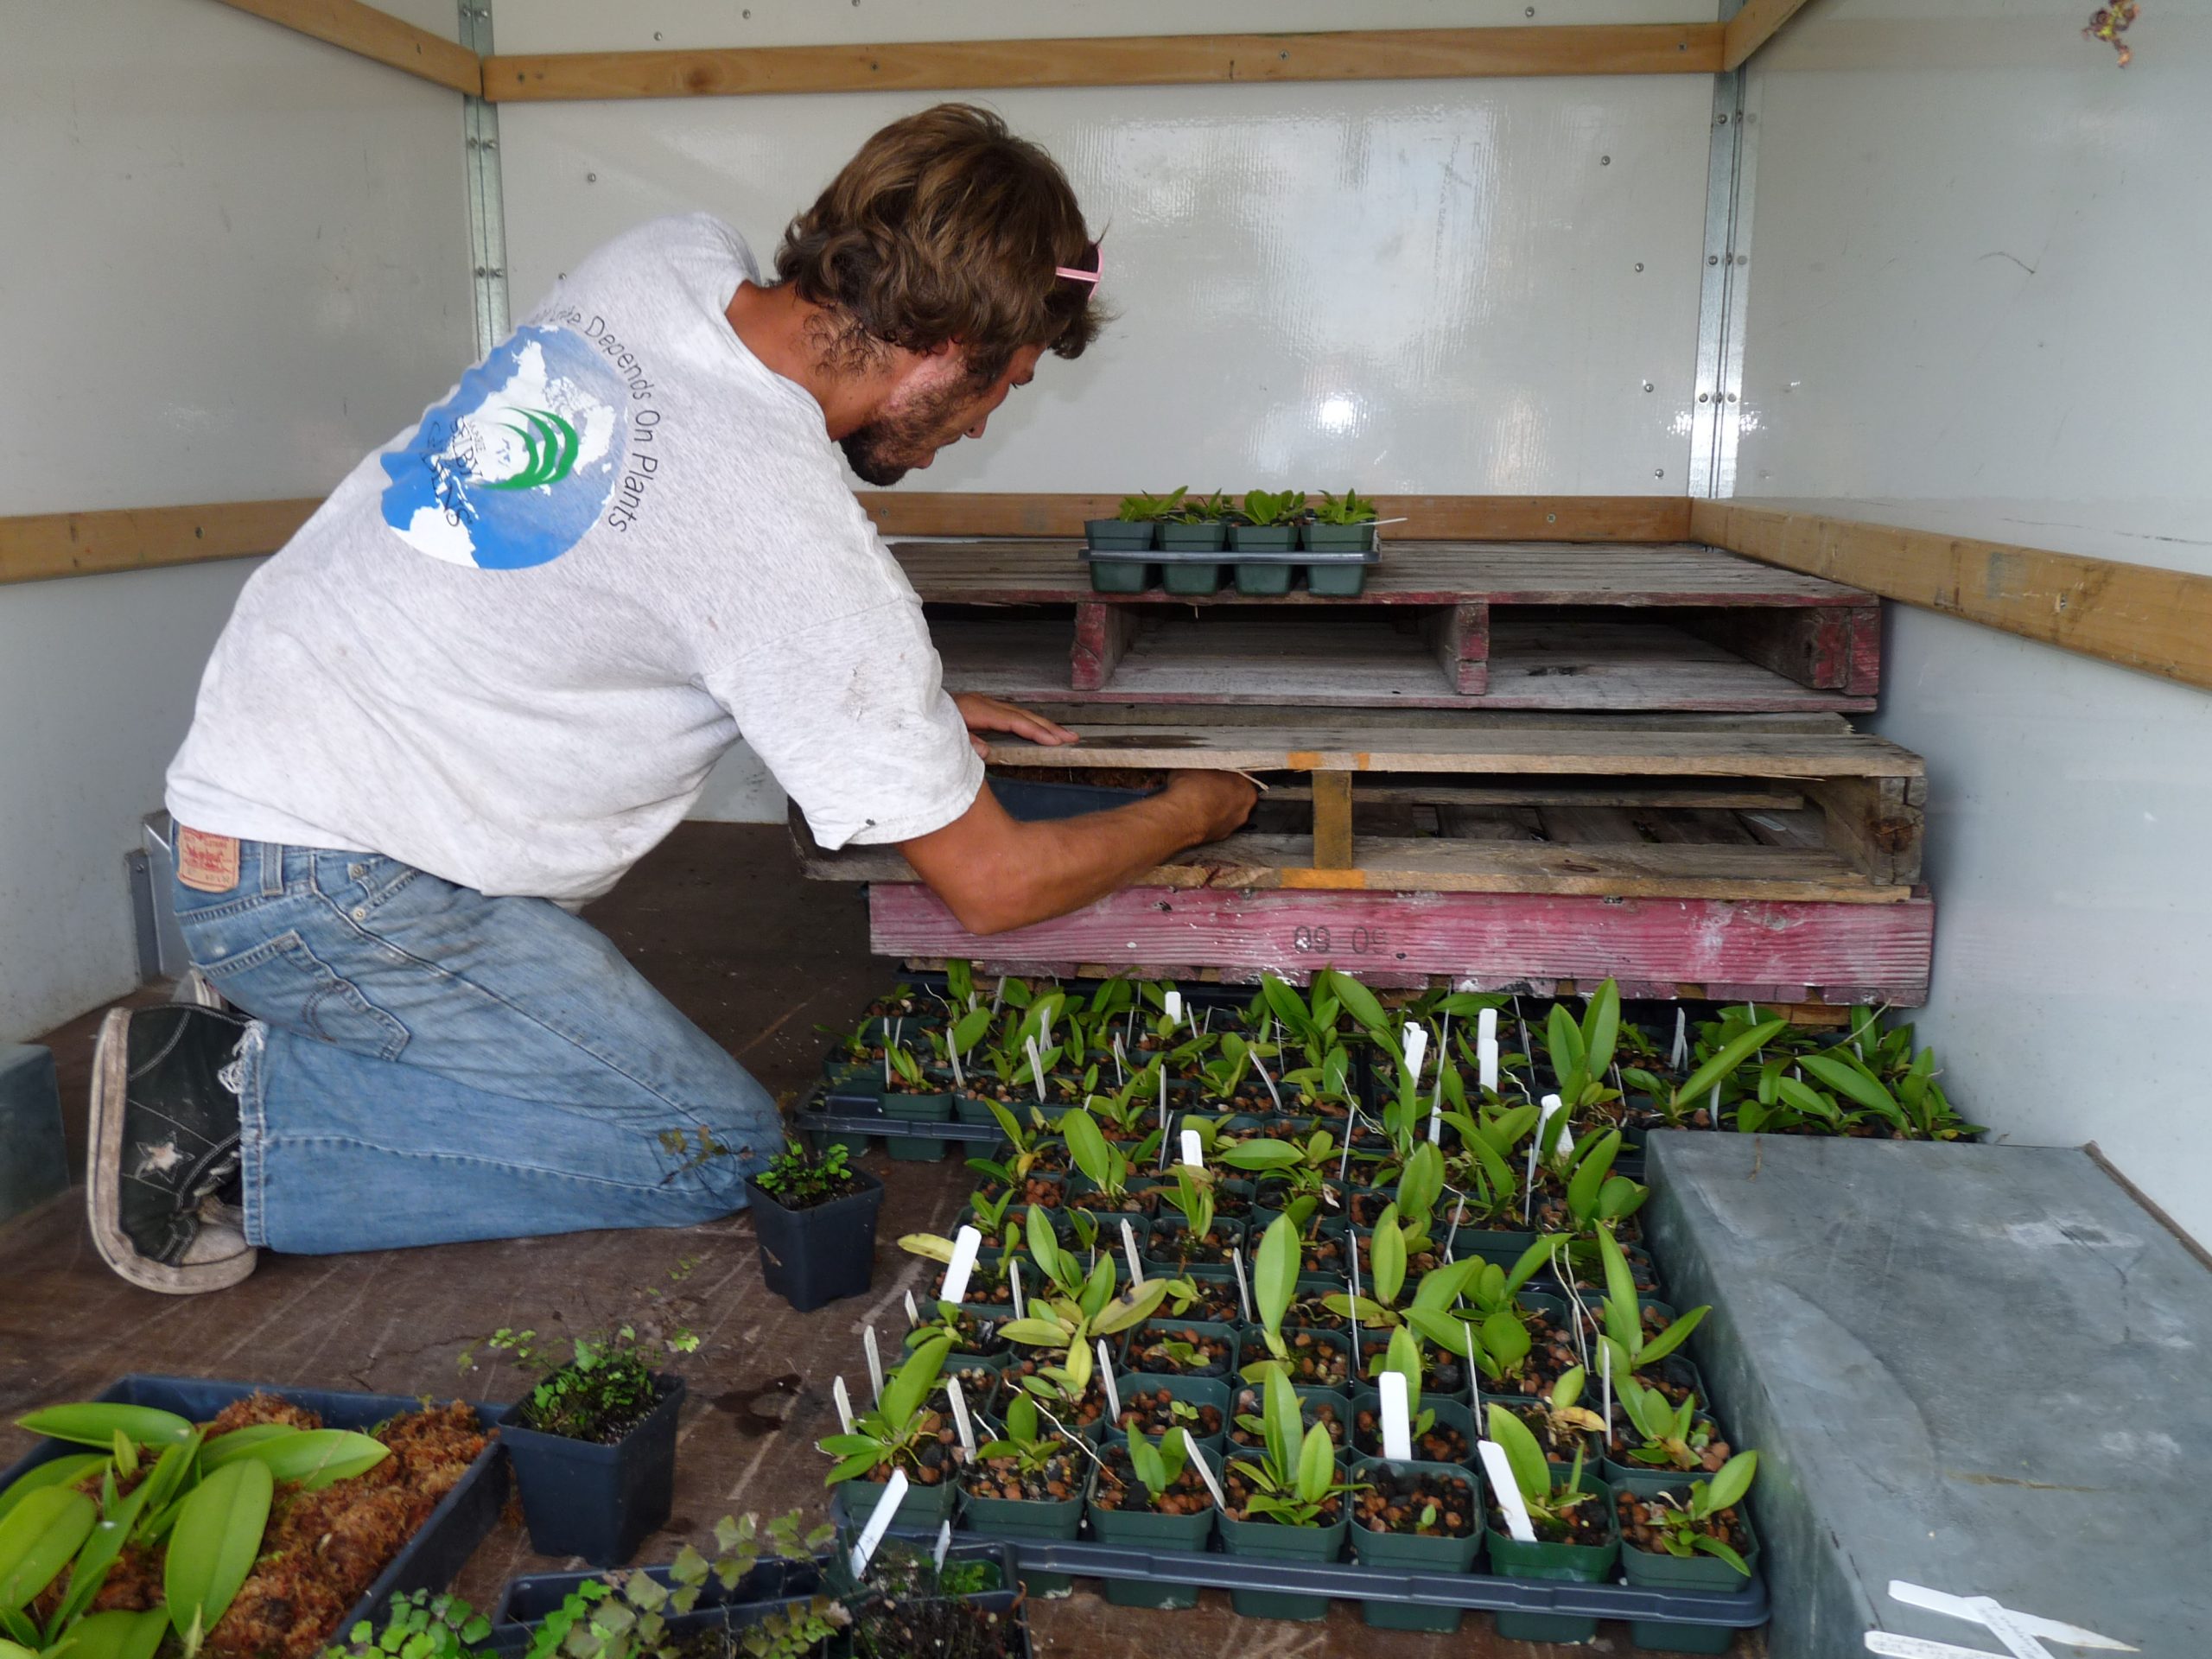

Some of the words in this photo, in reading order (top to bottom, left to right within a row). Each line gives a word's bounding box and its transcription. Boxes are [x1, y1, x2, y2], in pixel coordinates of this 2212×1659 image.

[584, 315, 652, 400] Depends
[633, 410, 661, 442] On
[608, 453, 658, 533] Plants
